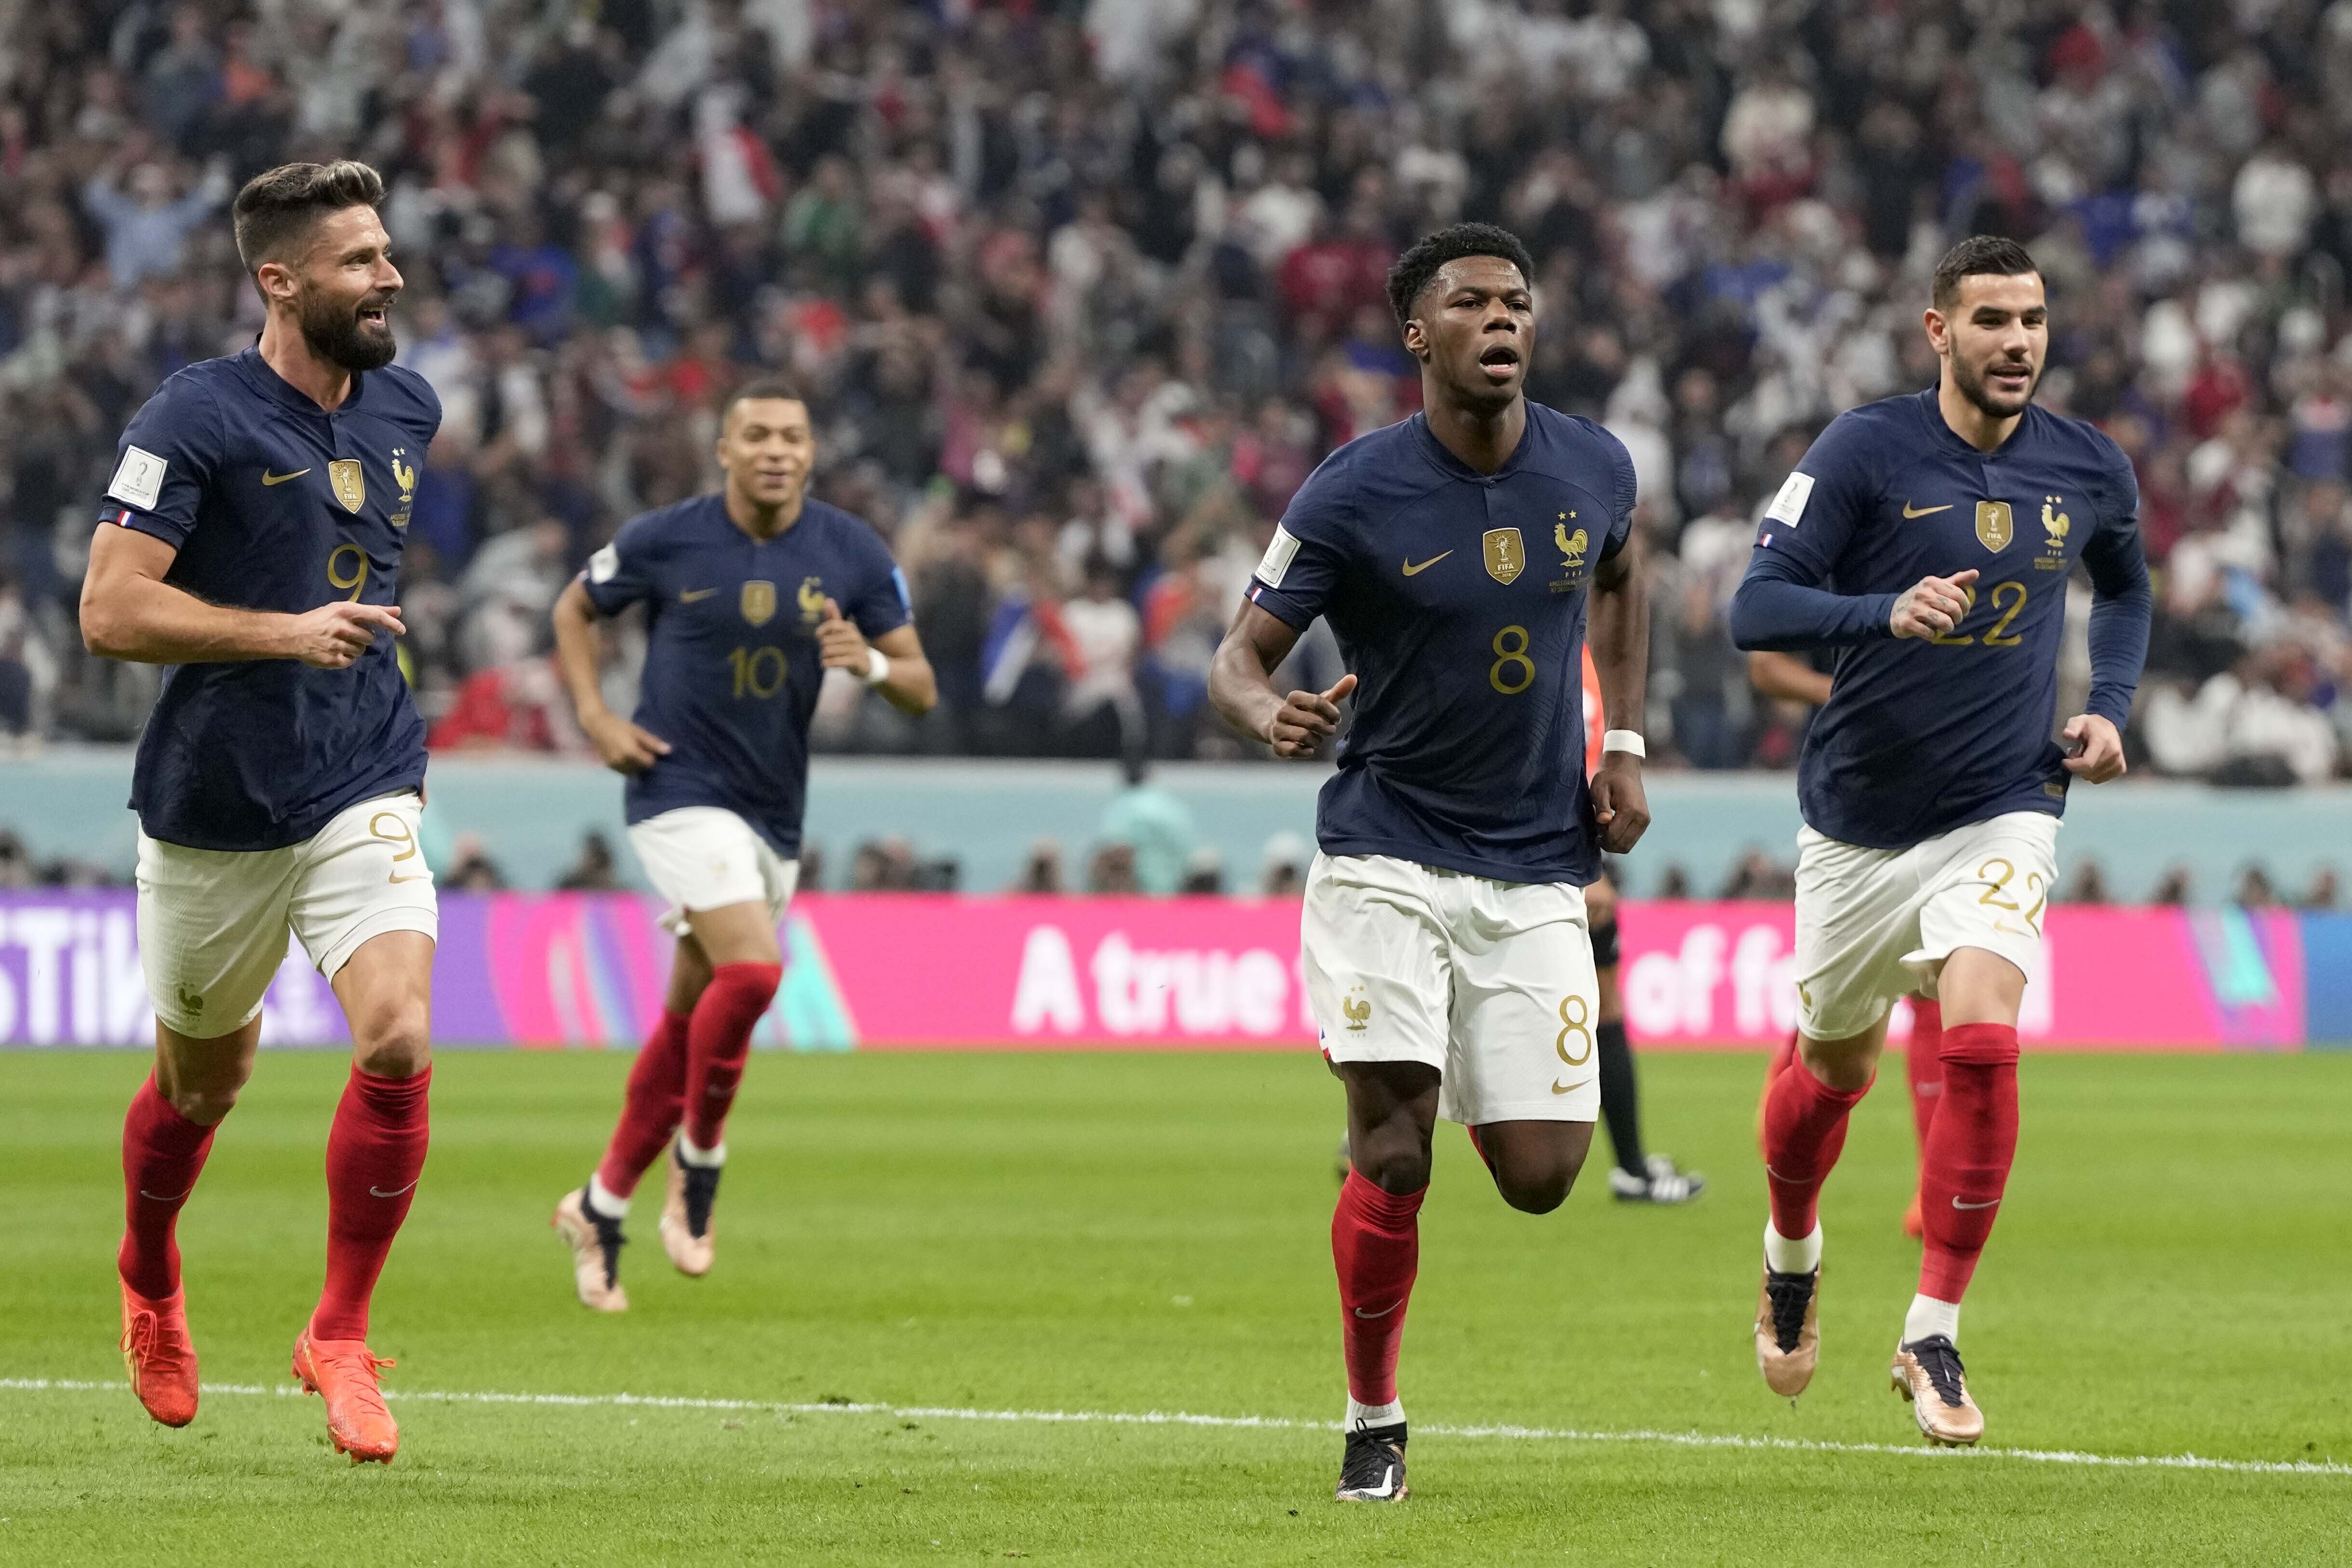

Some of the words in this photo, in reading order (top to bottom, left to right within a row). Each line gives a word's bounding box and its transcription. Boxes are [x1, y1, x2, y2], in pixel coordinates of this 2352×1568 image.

[328, 544, 368, 603] 9
[1497, 563, 1514, 571] FIFA
[1931, 581, 2027, 646] 22
[727, 646, 788, 699] 10
[1490, 625, 1536, 695] 8
[369, 812, 416, 862] 9
[1978, 857, 2045, 938] 22
[1011, 925, 1085, 1036] A
[1089, 933, 1289, 1036] true
[1624, 925, 1730, 1037] of
[1556, 994, 1591, 1066] 8
